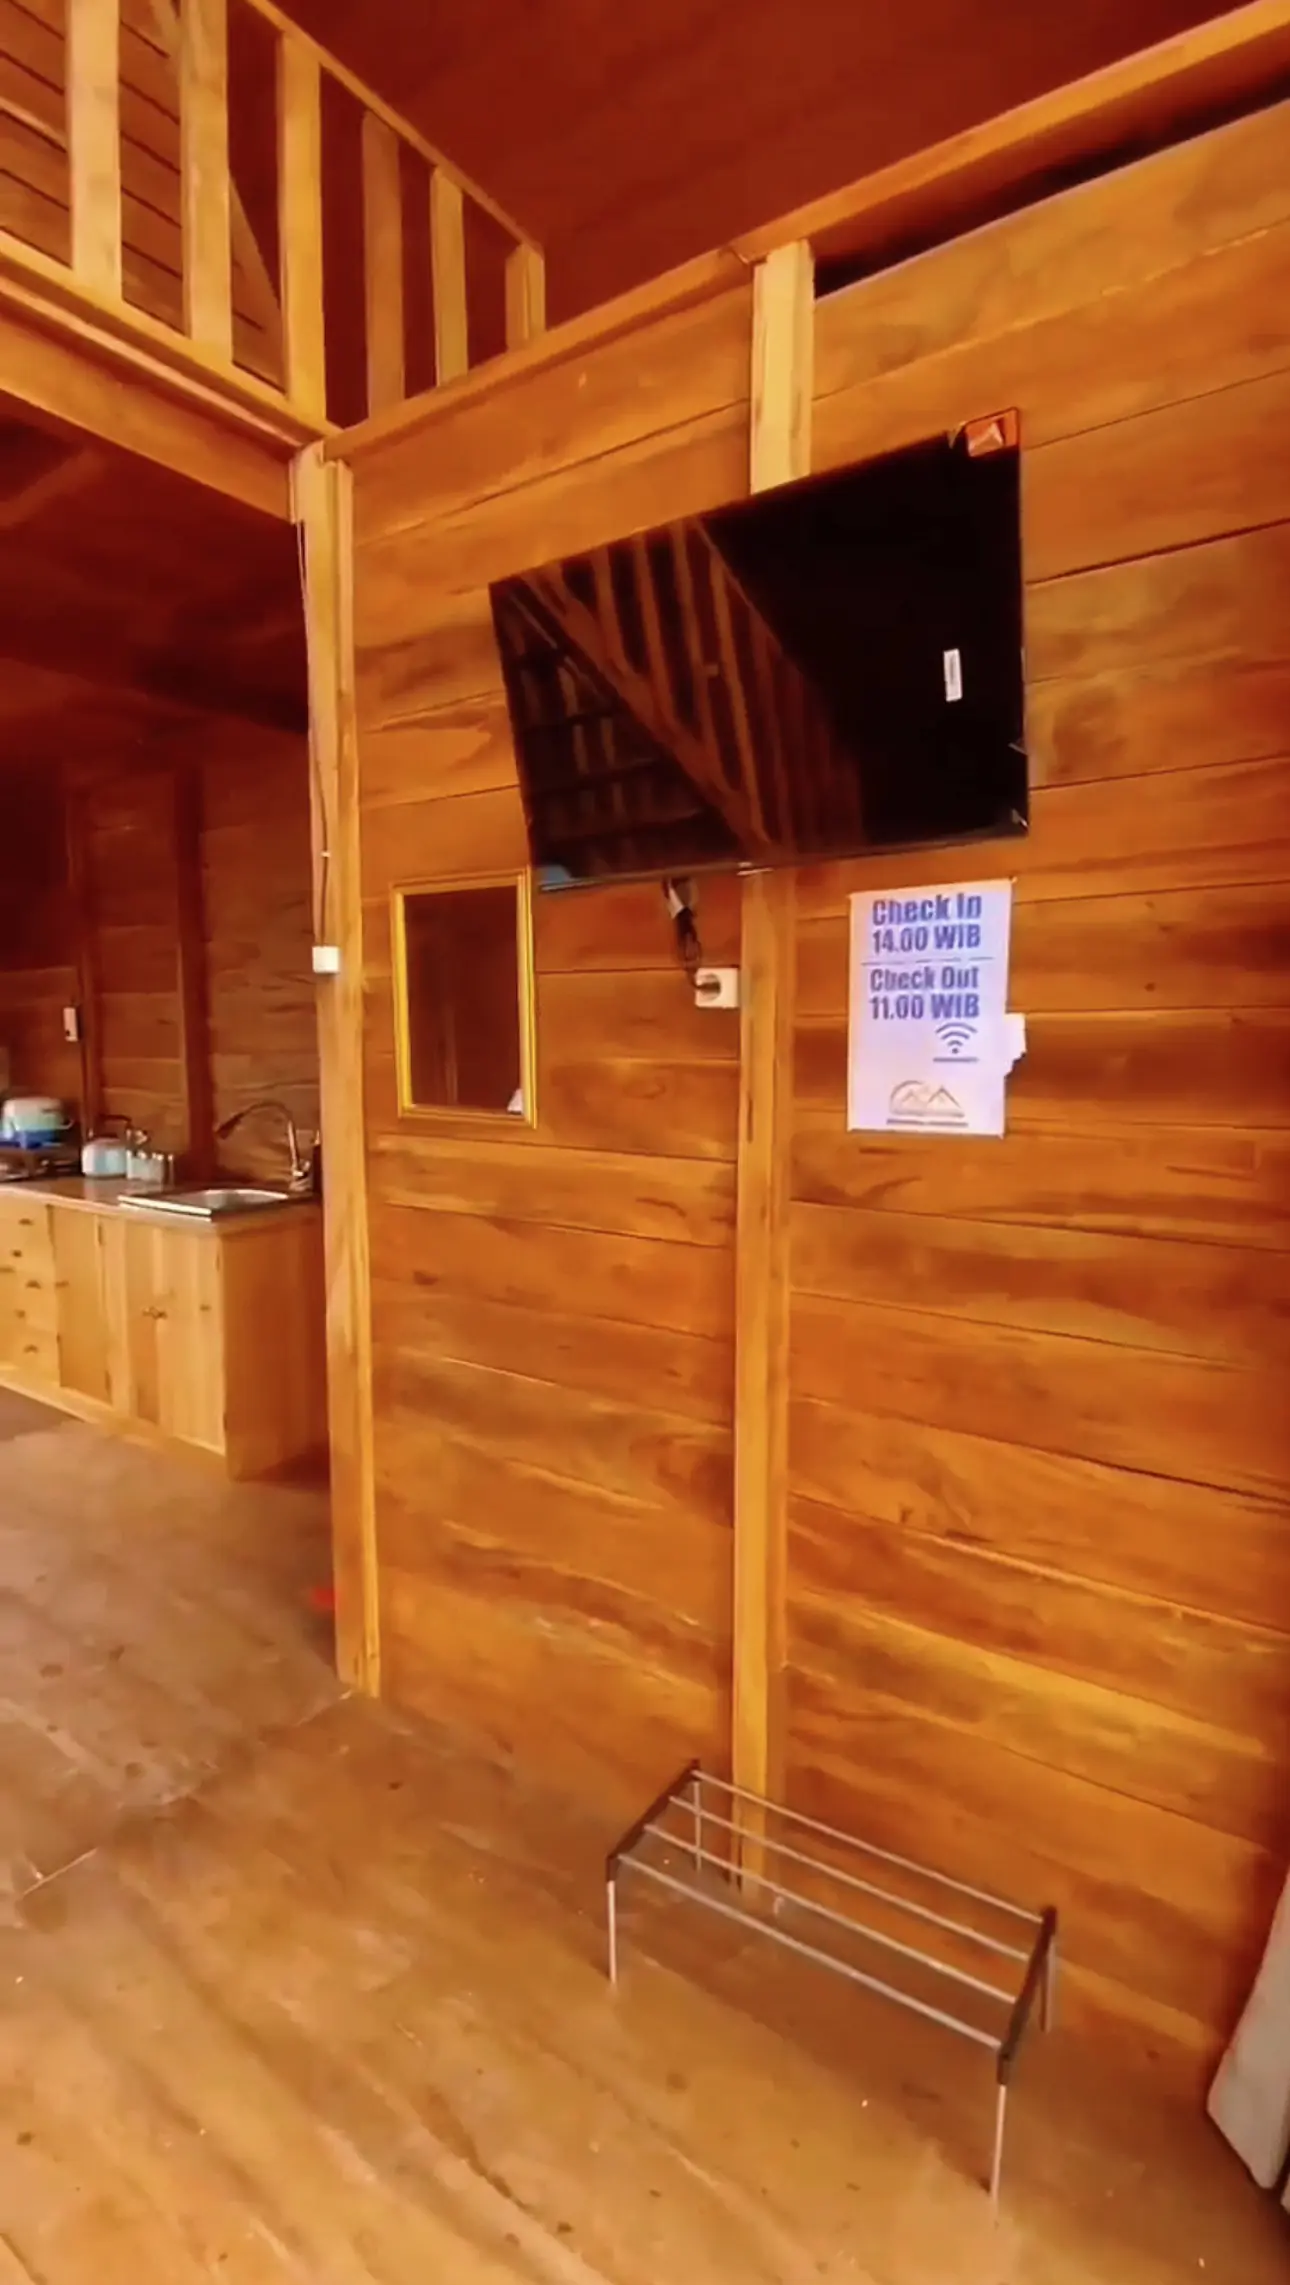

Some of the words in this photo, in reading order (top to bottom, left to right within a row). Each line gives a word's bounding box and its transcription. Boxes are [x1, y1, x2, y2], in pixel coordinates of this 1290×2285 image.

[872, 894, 949, 926] Check
[957, 893, 982, 919] In
[873, 928, 928, 954] 14.00
[934, 924, 981, 949] WIB
[870, 967, 935, 992] Check
[941, 966, 979, 990] Out
[871, 996, 924, 1020] 11.00
[931, 993, 980, 1019] WIB
